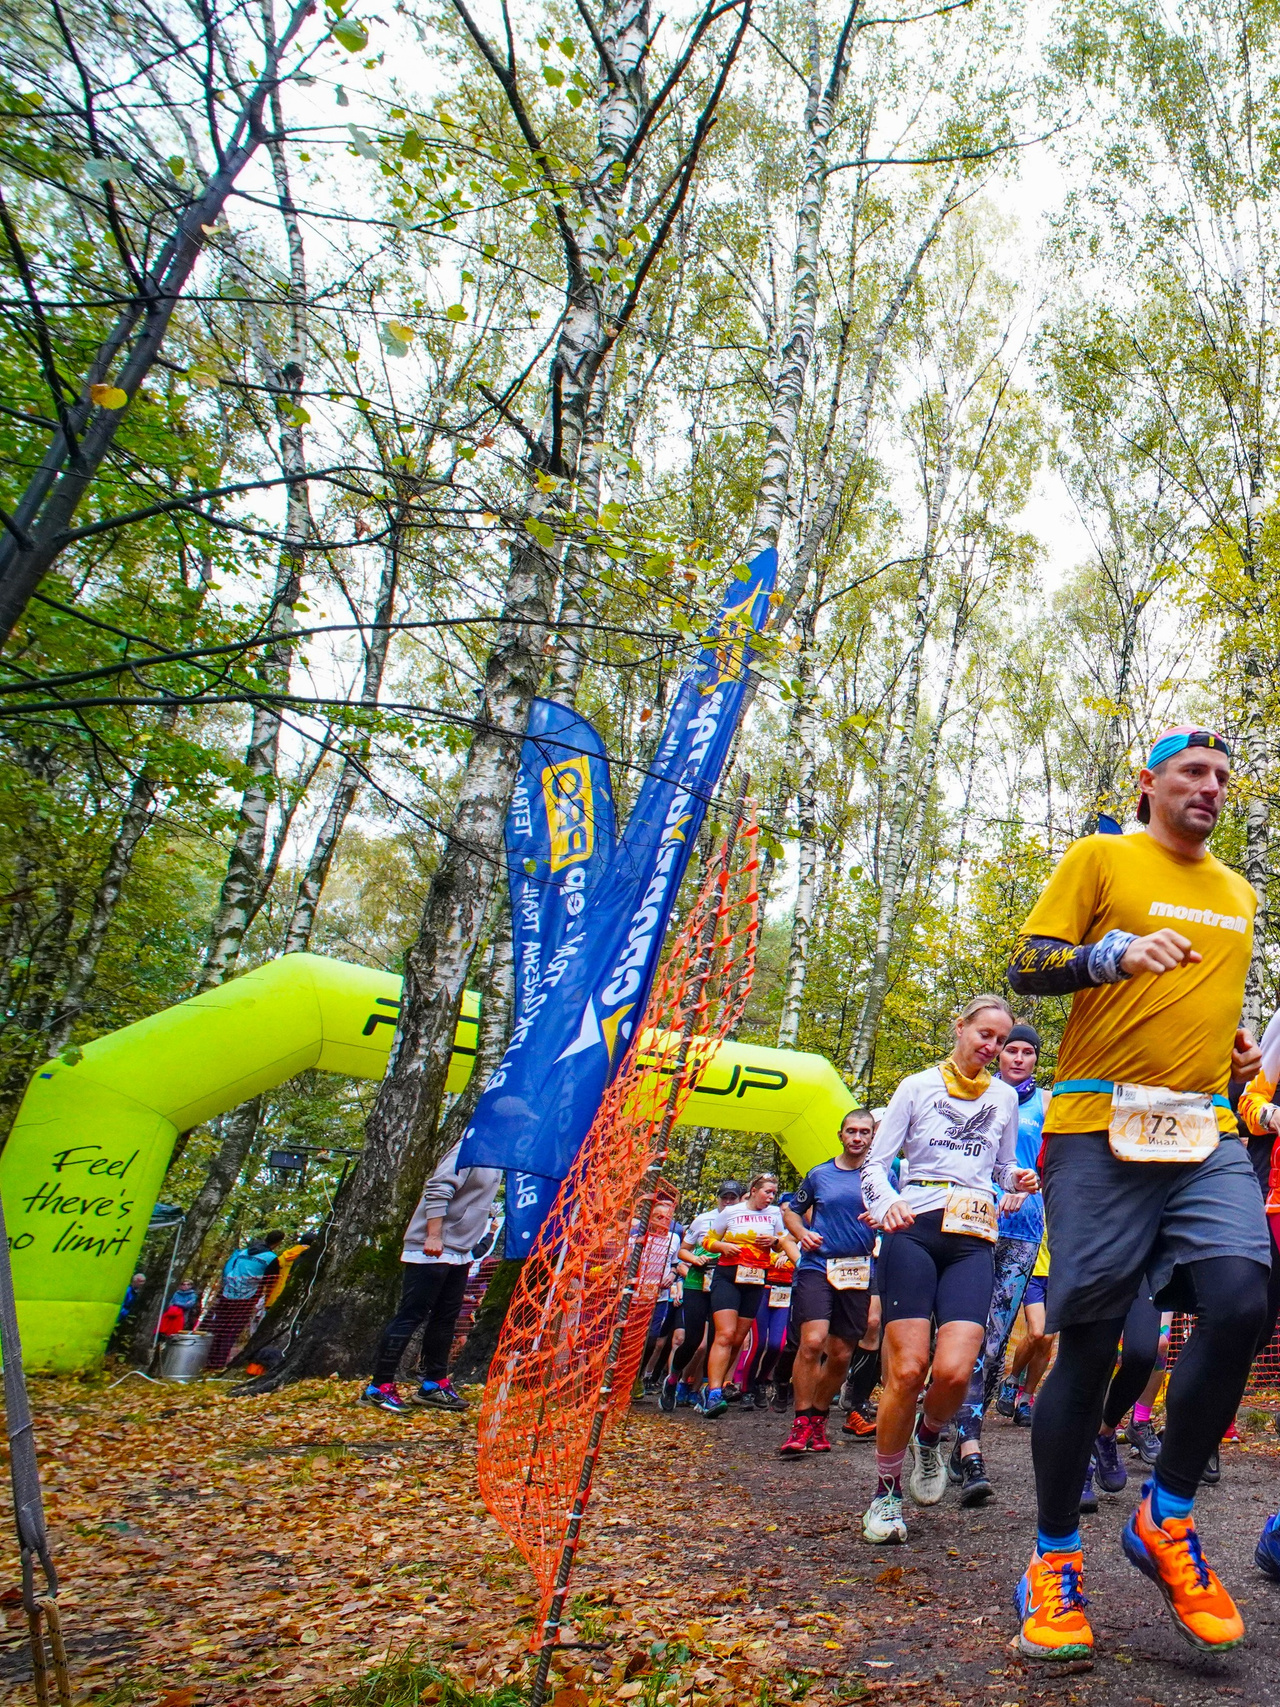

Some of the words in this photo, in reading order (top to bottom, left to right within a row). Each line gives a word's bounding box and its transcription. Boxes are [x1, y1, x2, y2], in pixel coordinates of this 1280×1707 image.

[1151, 1114, 1178, 1136] 72
[1148, 1136, 1179, 1146] Инал
[52, 1145, 140, 1179] Feel
[22, 1182, 134, 1219] there's
[971, 1200, 988, 1216] 14
[736, 1215, 772, 1224] IZMYLONG
[52, 1220, 133, 1257] limit
[840, 1267, 860, 1277] 148
